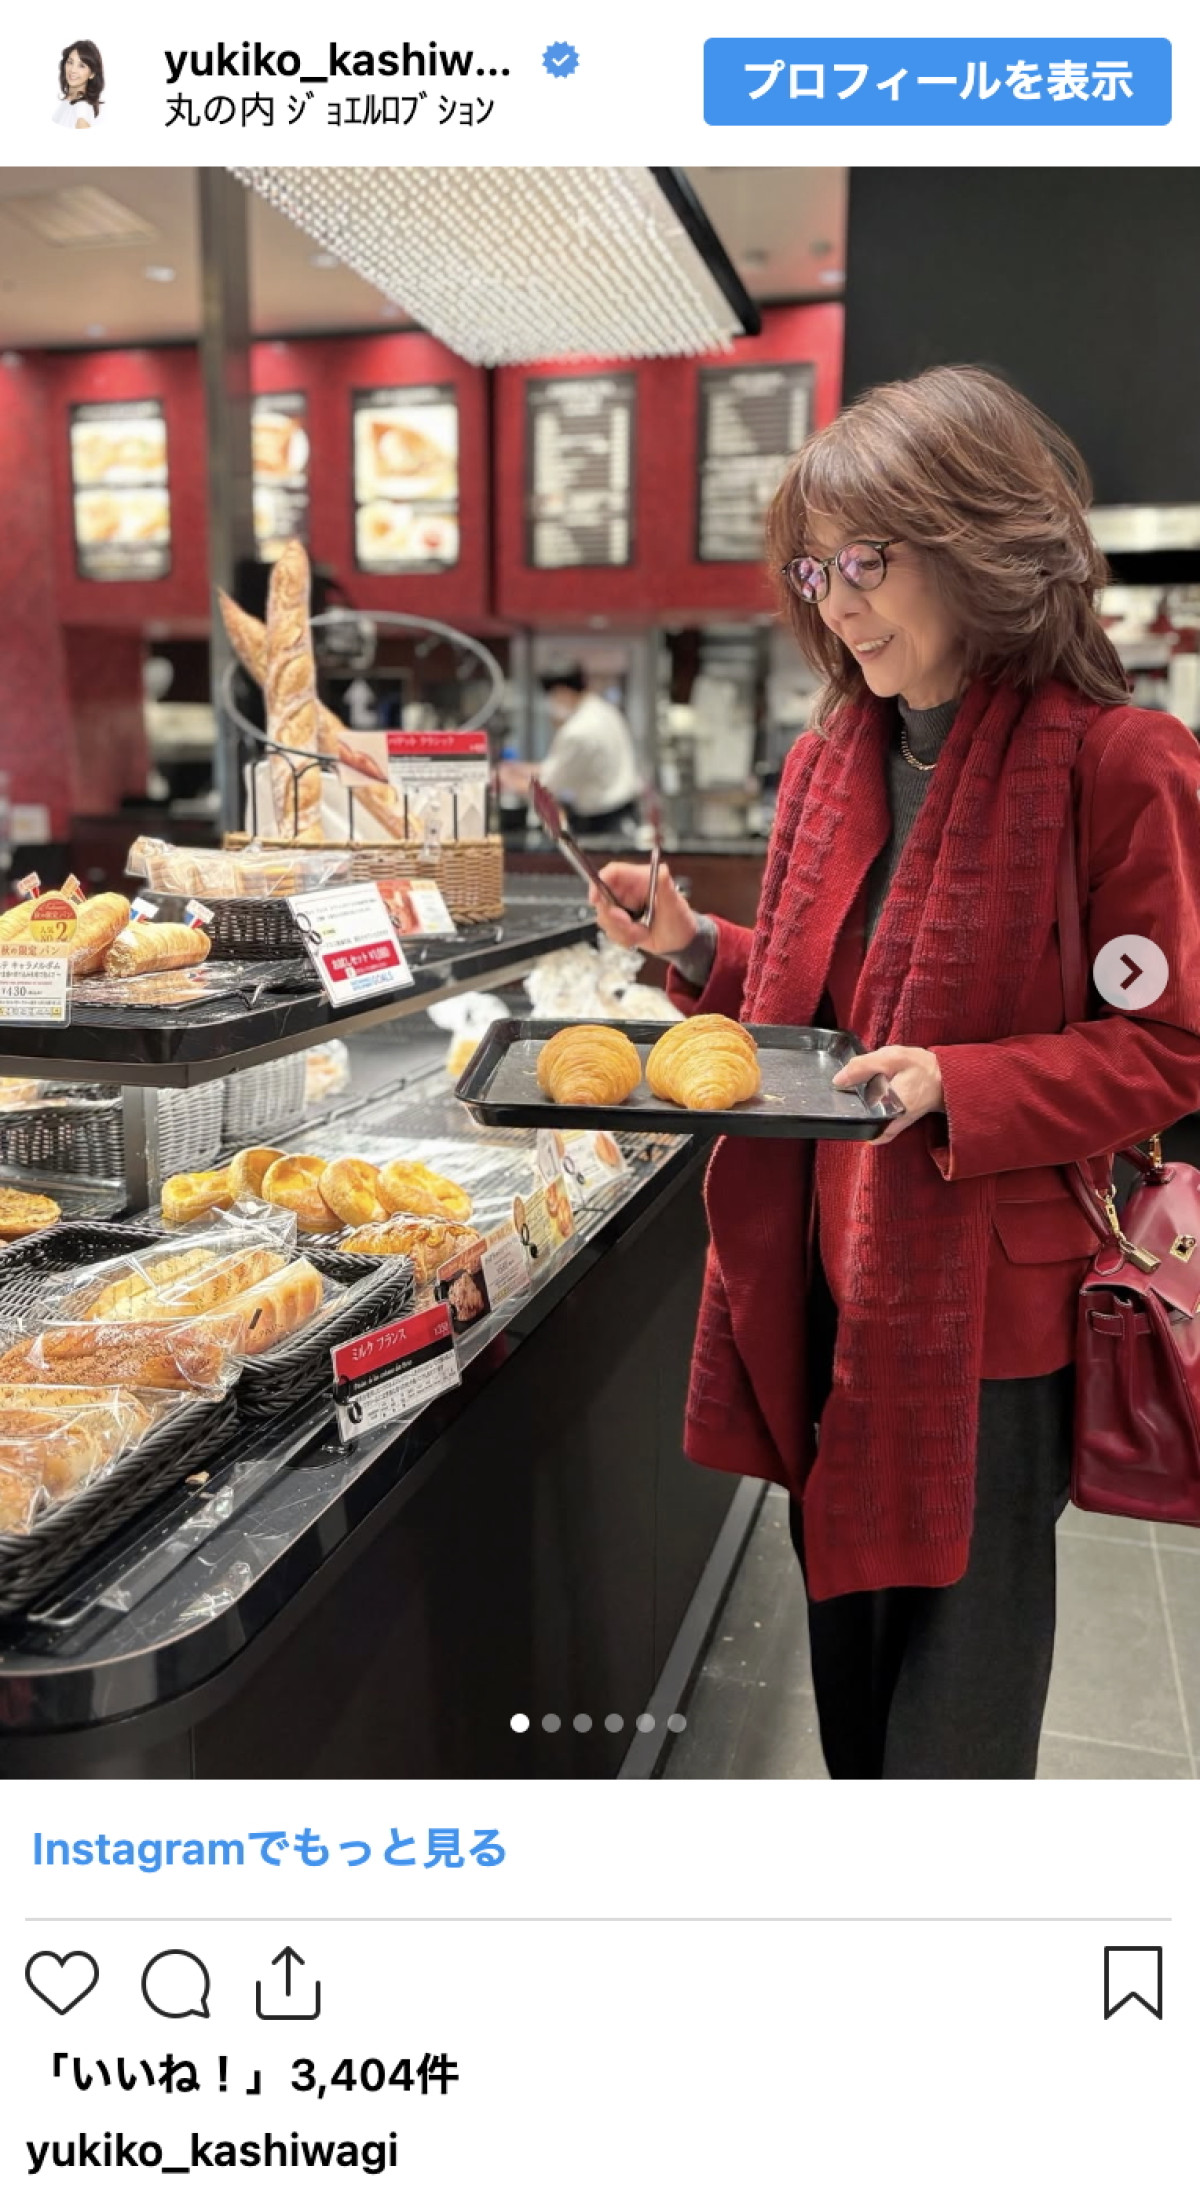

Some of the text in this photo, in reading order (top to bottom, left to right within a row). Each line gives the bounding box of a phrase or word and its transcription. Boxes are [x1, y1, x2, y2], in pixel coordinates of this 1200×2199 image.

[351, 1341, 374, 1361] ミルク
[376, 1327, 407, 1351] フランス
